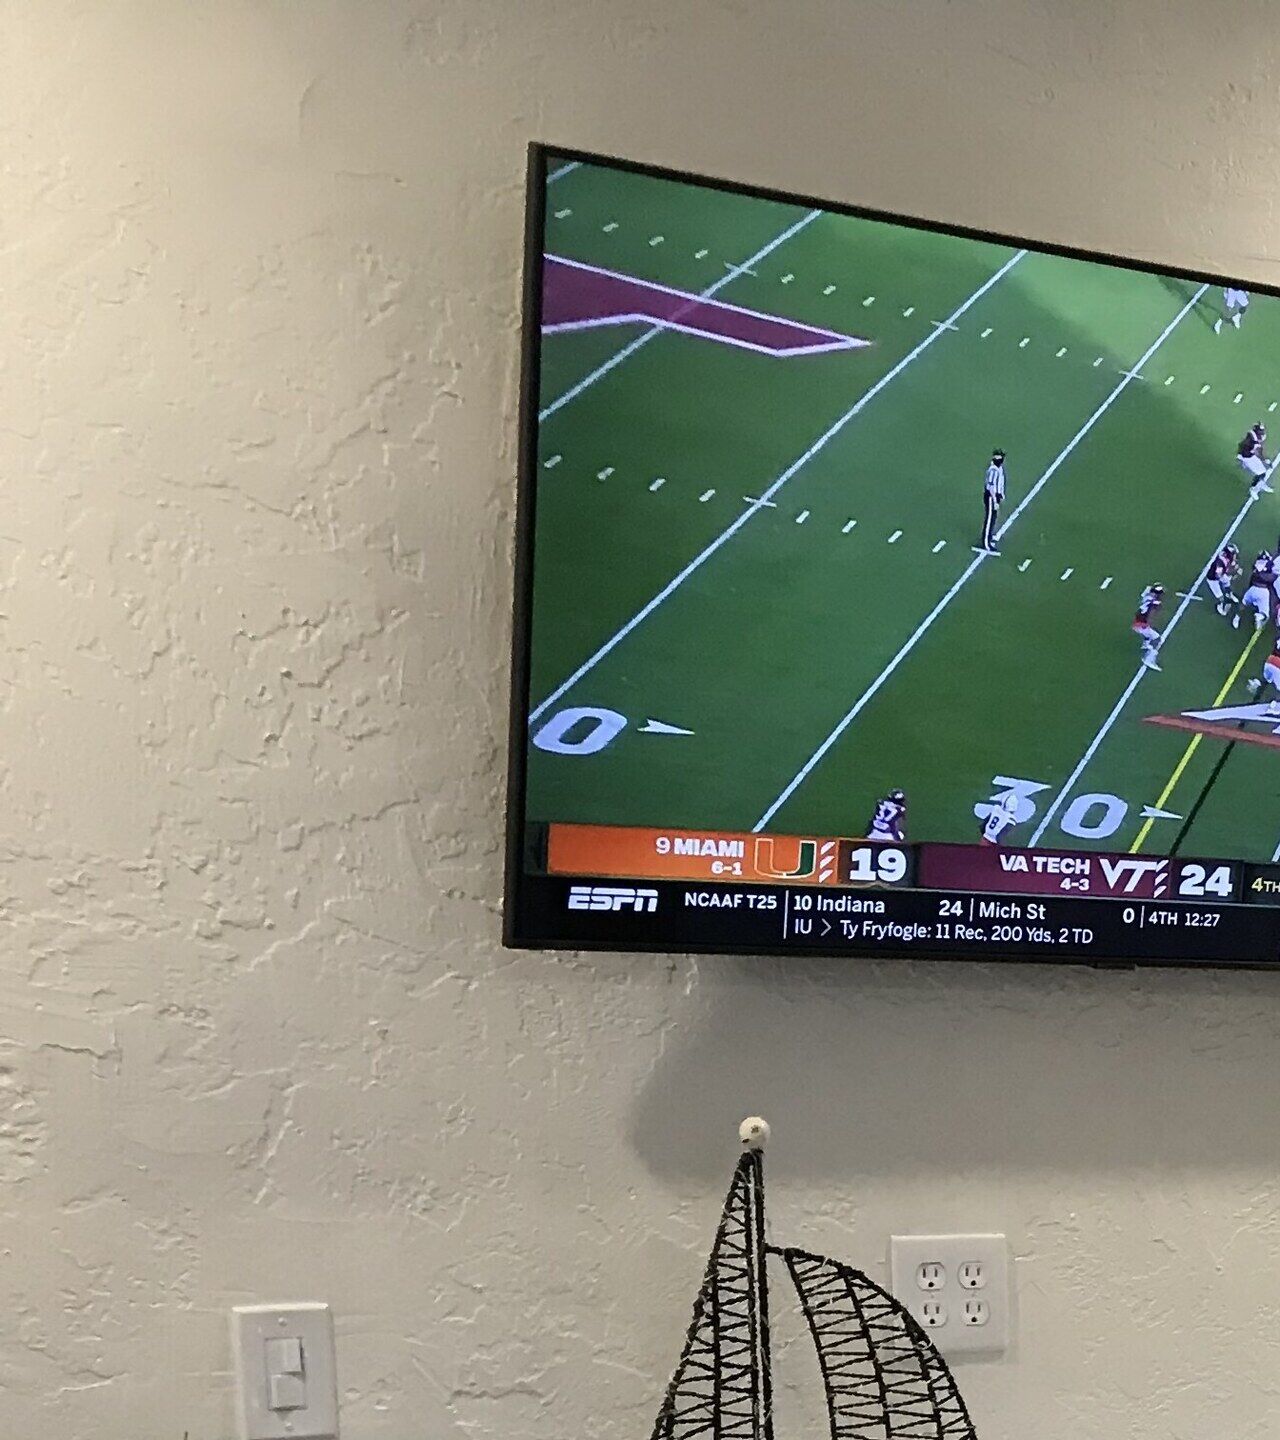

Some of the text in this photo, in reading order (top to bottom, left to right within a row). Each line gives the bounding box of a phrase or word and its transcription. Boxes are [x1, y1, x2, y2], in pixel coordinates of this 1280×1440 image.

[655, 836, 745, 858] 9 MIAMI
[711, 861, 743, 876] 6-1
[850, 848, 907, 882] 19
[1000, 854, 1090, 875] VA TECH
[1060, 878, 1090, 891] 4-3
[1178, 864, 1233, 896] 24
[568, 886, 659, 912] ESPN
[685, 892, 777, 909] NCAAF T25
[793, 895, 885, 914] 10 Indiana
[939, 900, 963, 917] 24
[979, 902, 1046, 920] Mich St
[1122, 908, 1135, 924] 0
[795, 919, 812, 934] IU
[1149, 912, 1221, 928] 4TH 12:27
[840, 920, 858, 939] Ty
[862, 922, 931, 941] Fryfogle:
[954, 924, 988, 942] Rec,
[991, 926, 1023, 941] 200
[1026, 927, 1055, 944] Yds,
[1058, 928, 1069, 943] 2
[1073, 929, 1094, 944] TD
